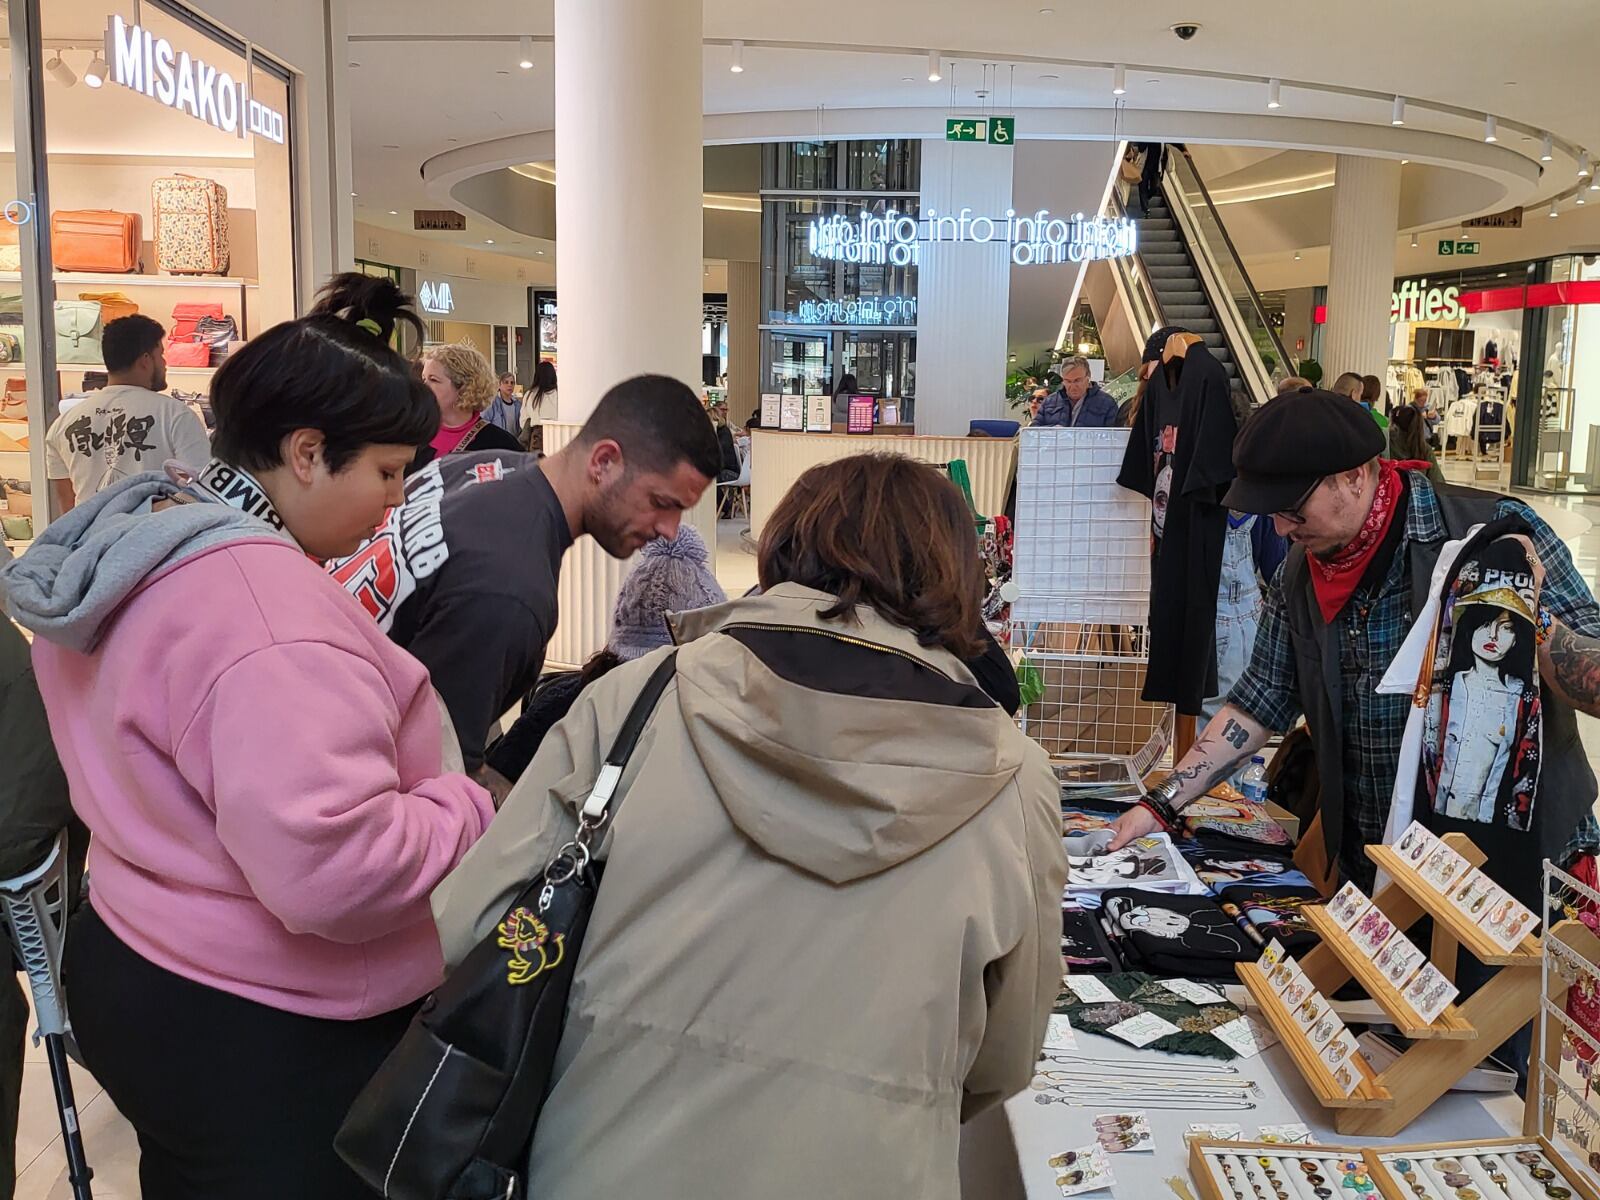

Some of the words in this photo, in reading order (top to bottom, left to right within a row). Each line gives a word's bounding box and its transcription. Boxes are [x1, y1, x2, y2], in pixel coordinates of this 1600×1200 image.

[112, 14, 237, 133] MISAKO
[860, 209, 917, 244] info
[927, 207, 995, 243] info
[1006, 208, 1067, 245] info
[431, 281, 455, 310] MIA
[1221, 718, 1250, 750] 138
